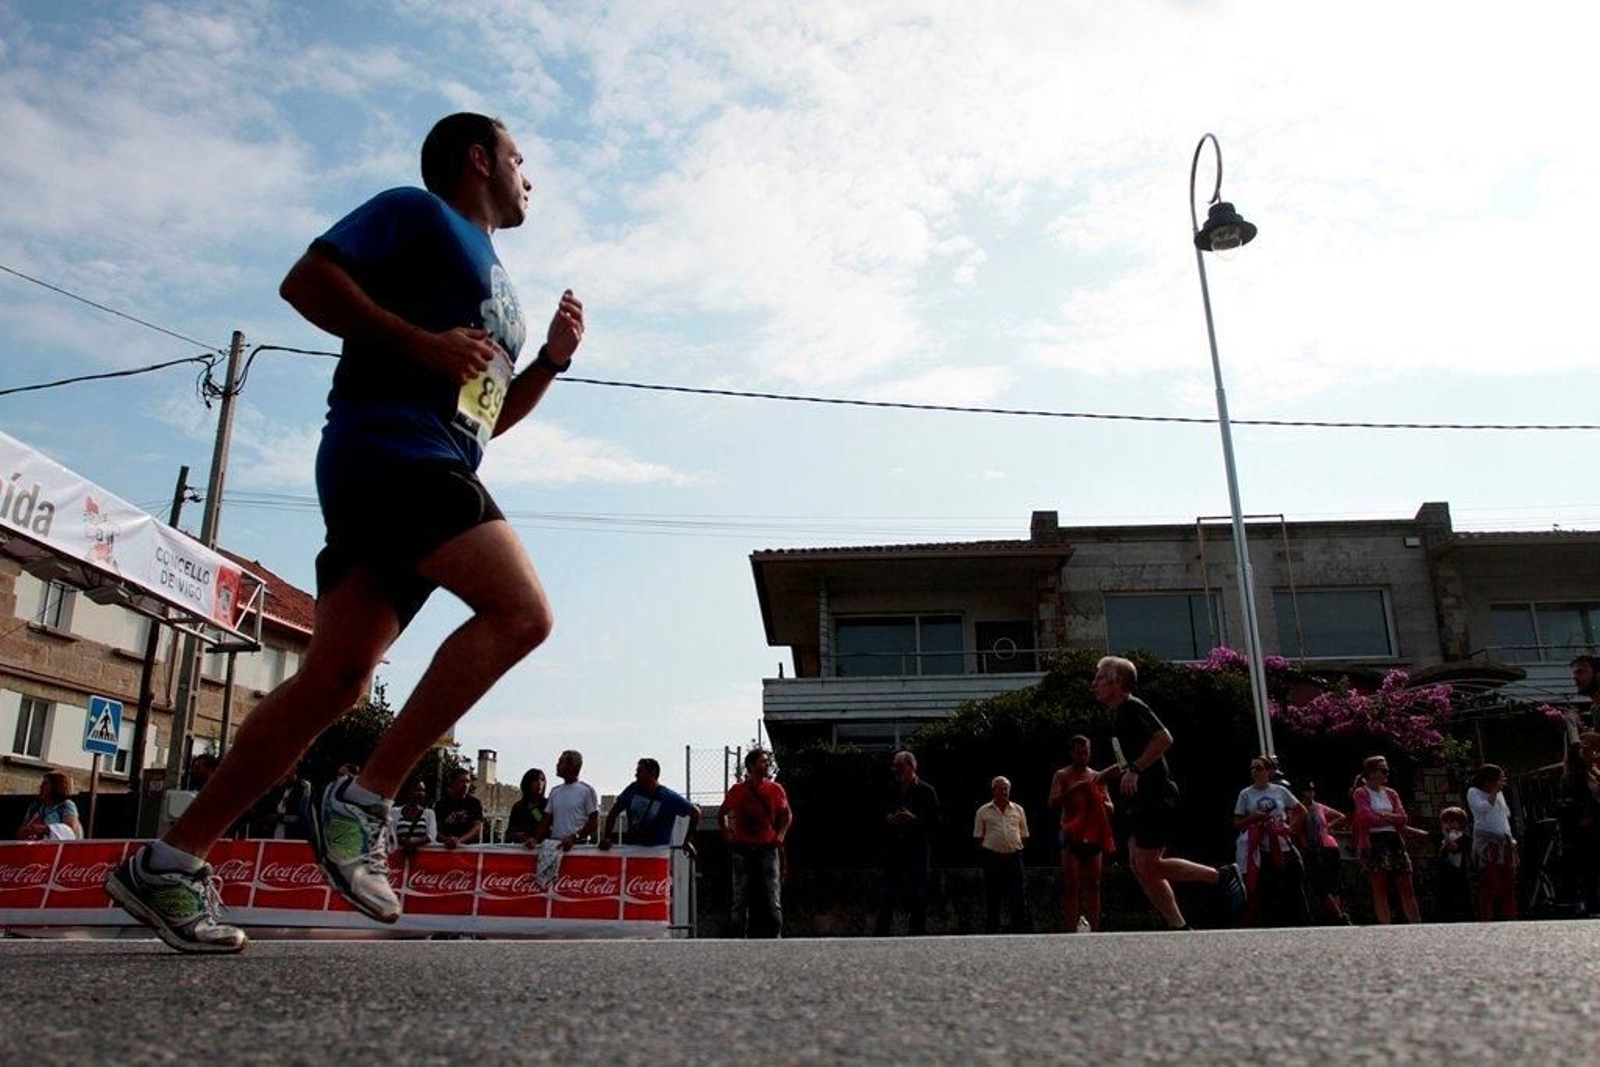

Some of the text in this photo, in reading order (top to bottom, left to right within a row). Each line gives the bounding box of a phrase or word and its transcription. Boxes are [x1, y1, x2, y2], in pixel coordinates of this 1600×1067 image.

[155, 546, 210, 585] CONCELLO
[160, 569, 202, 601] DE VIGO
